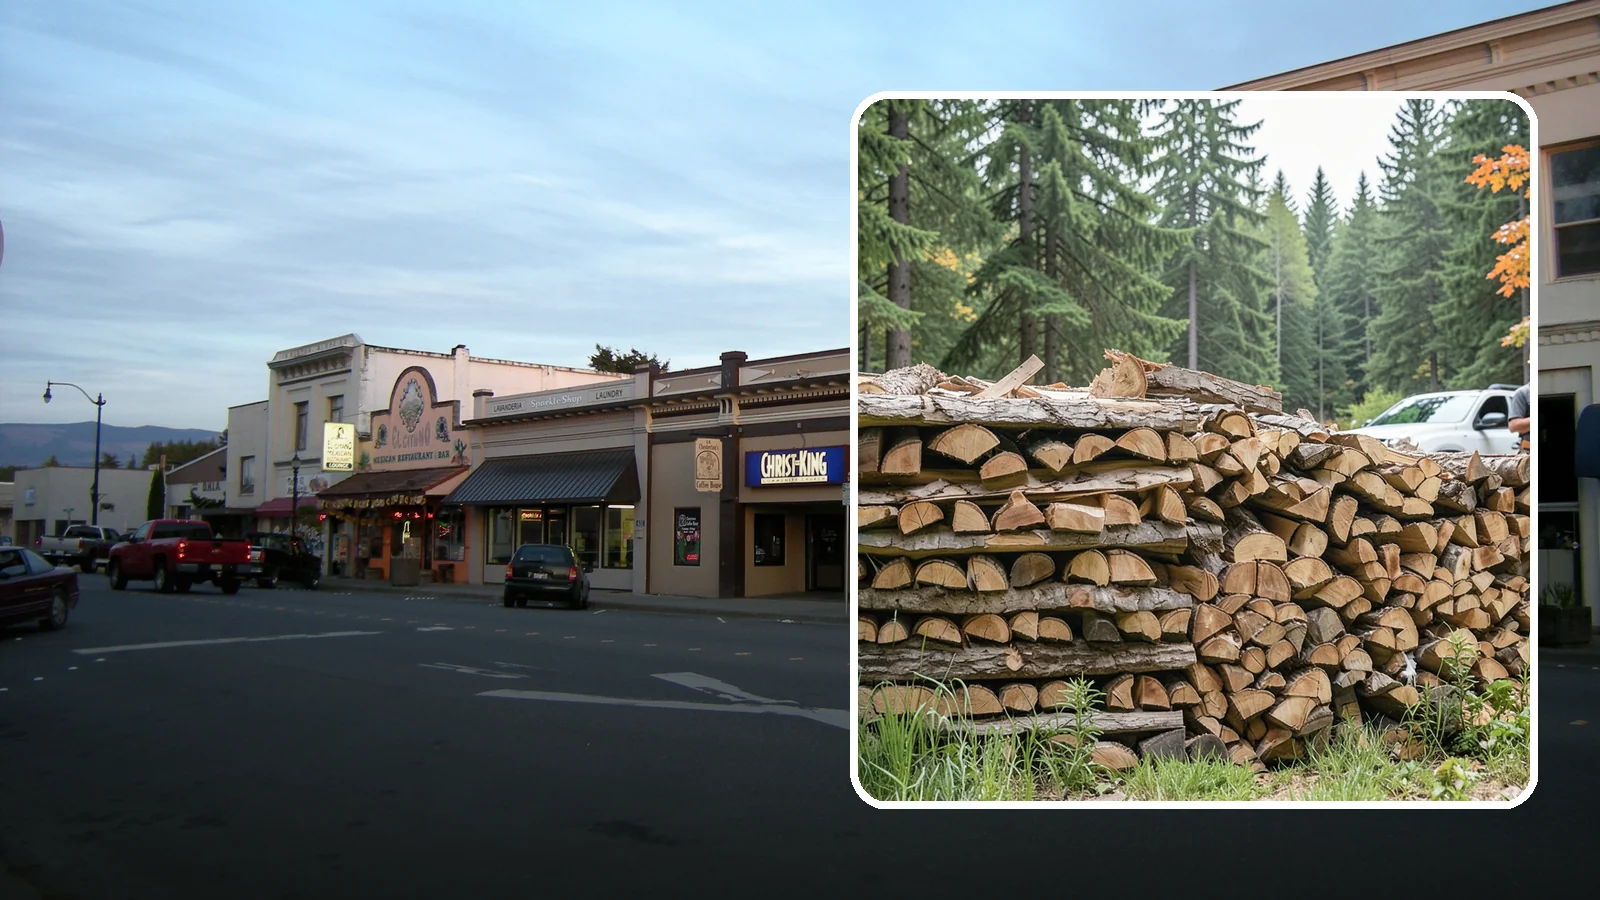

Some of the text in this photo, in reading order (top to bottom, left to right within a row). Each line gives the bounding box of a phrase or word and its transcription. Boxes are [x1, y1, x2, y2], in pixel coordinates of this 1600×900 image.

[595, 388, 623, 400] LAUNDRY
[493, 402, 522, 413] LAVANDERIA
[531, 394, 582, 409] Sparkle Shop
[373, 454, 396, 464] MEXICAN
[397, 451, 433, 462] RESTAURANT
[438, 450, 450, 459] BAR
[761, 450, 827, 478] CHRIST KING
[696, 480, 721, 489] Coffee House
